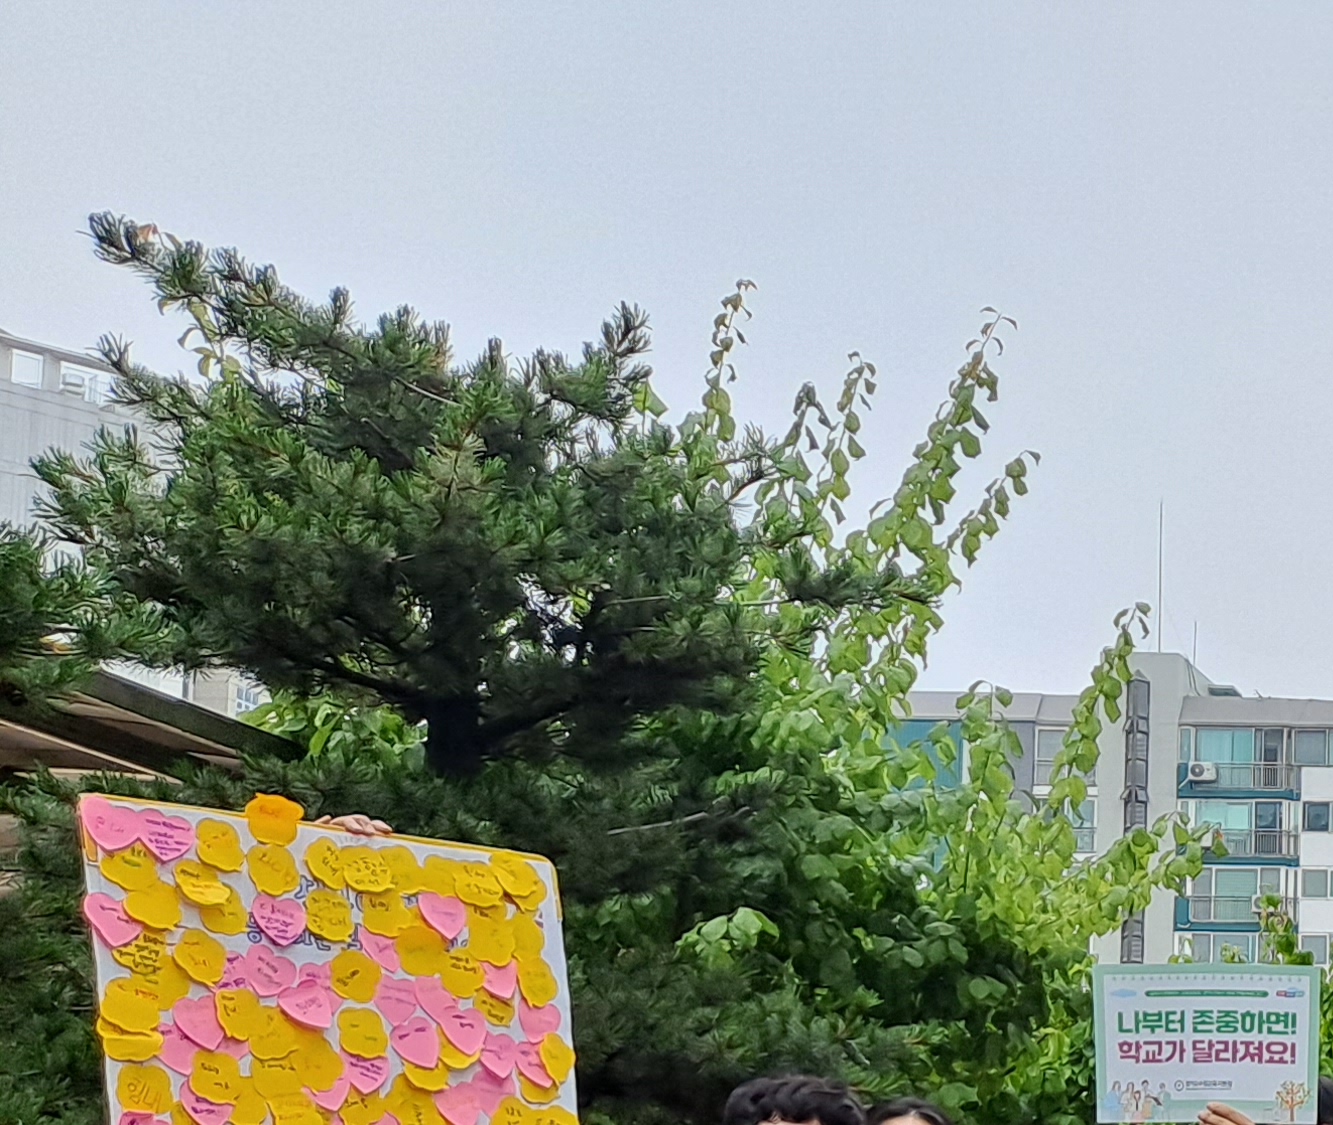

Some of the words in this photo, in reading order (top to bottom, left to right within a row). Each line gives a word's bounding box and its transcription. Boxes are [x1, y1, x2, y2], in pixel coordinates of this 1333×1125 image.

[1117, 1010, 1187, 1035] 나부터
[1191, 1009, 1297, 1035] 존중하면!
[1117, 1039, 1187, 1065] 학교가
[1191, 1039, 1297, 1066] 달라져요!
